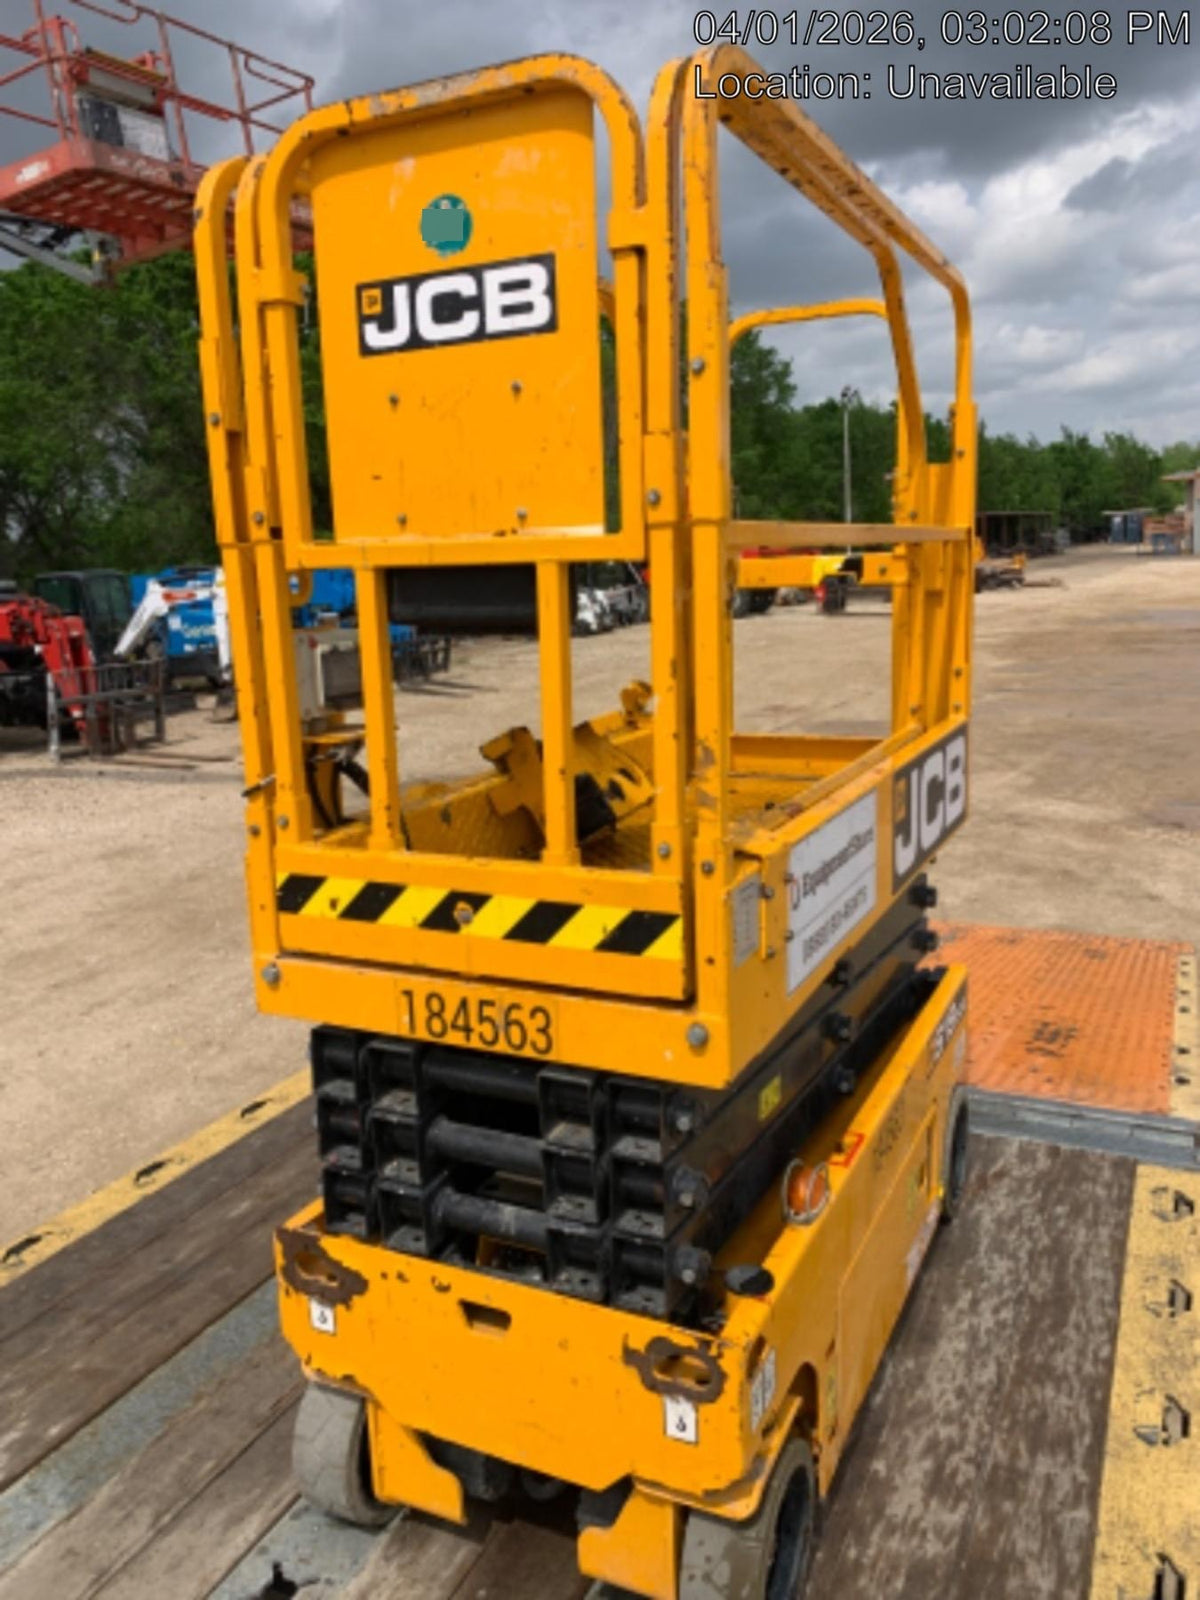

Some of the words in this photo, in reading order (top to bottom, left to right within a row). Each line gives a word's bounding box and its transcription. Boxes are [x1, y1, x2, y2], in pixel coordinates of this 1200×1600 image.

[363, 262, 552, 350] JCB
[894, 735, 967, 878] JCB
[402, 989, 553, 1055] 184563
